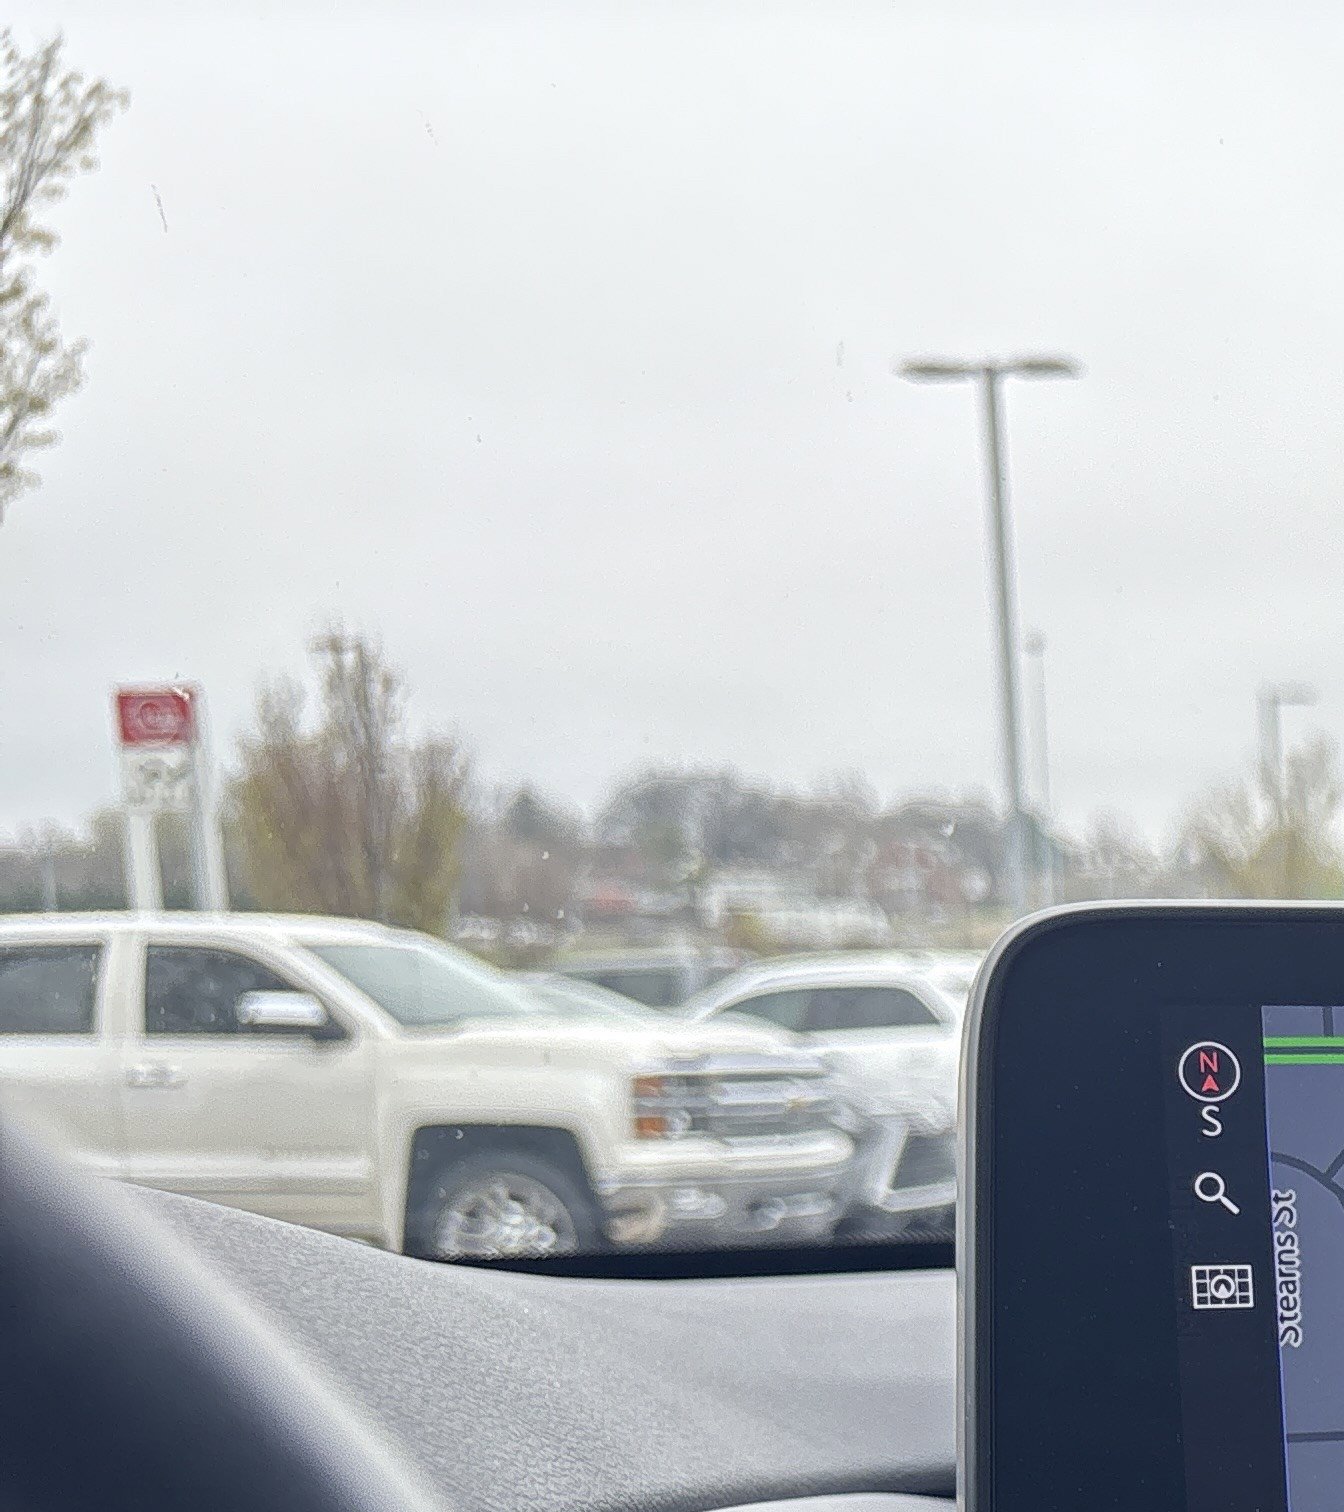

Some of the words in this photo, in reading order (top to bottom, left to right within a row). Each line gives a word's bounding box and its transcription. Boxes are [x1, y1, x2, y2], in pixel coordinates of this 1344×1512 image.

[1200, 1051, 1218, 1073] N
[1202, 1105, 1222, 1136] S
[1273, 1191, 1295, 1227] St
[1276, 1233, 1300, 1346] Stearns
